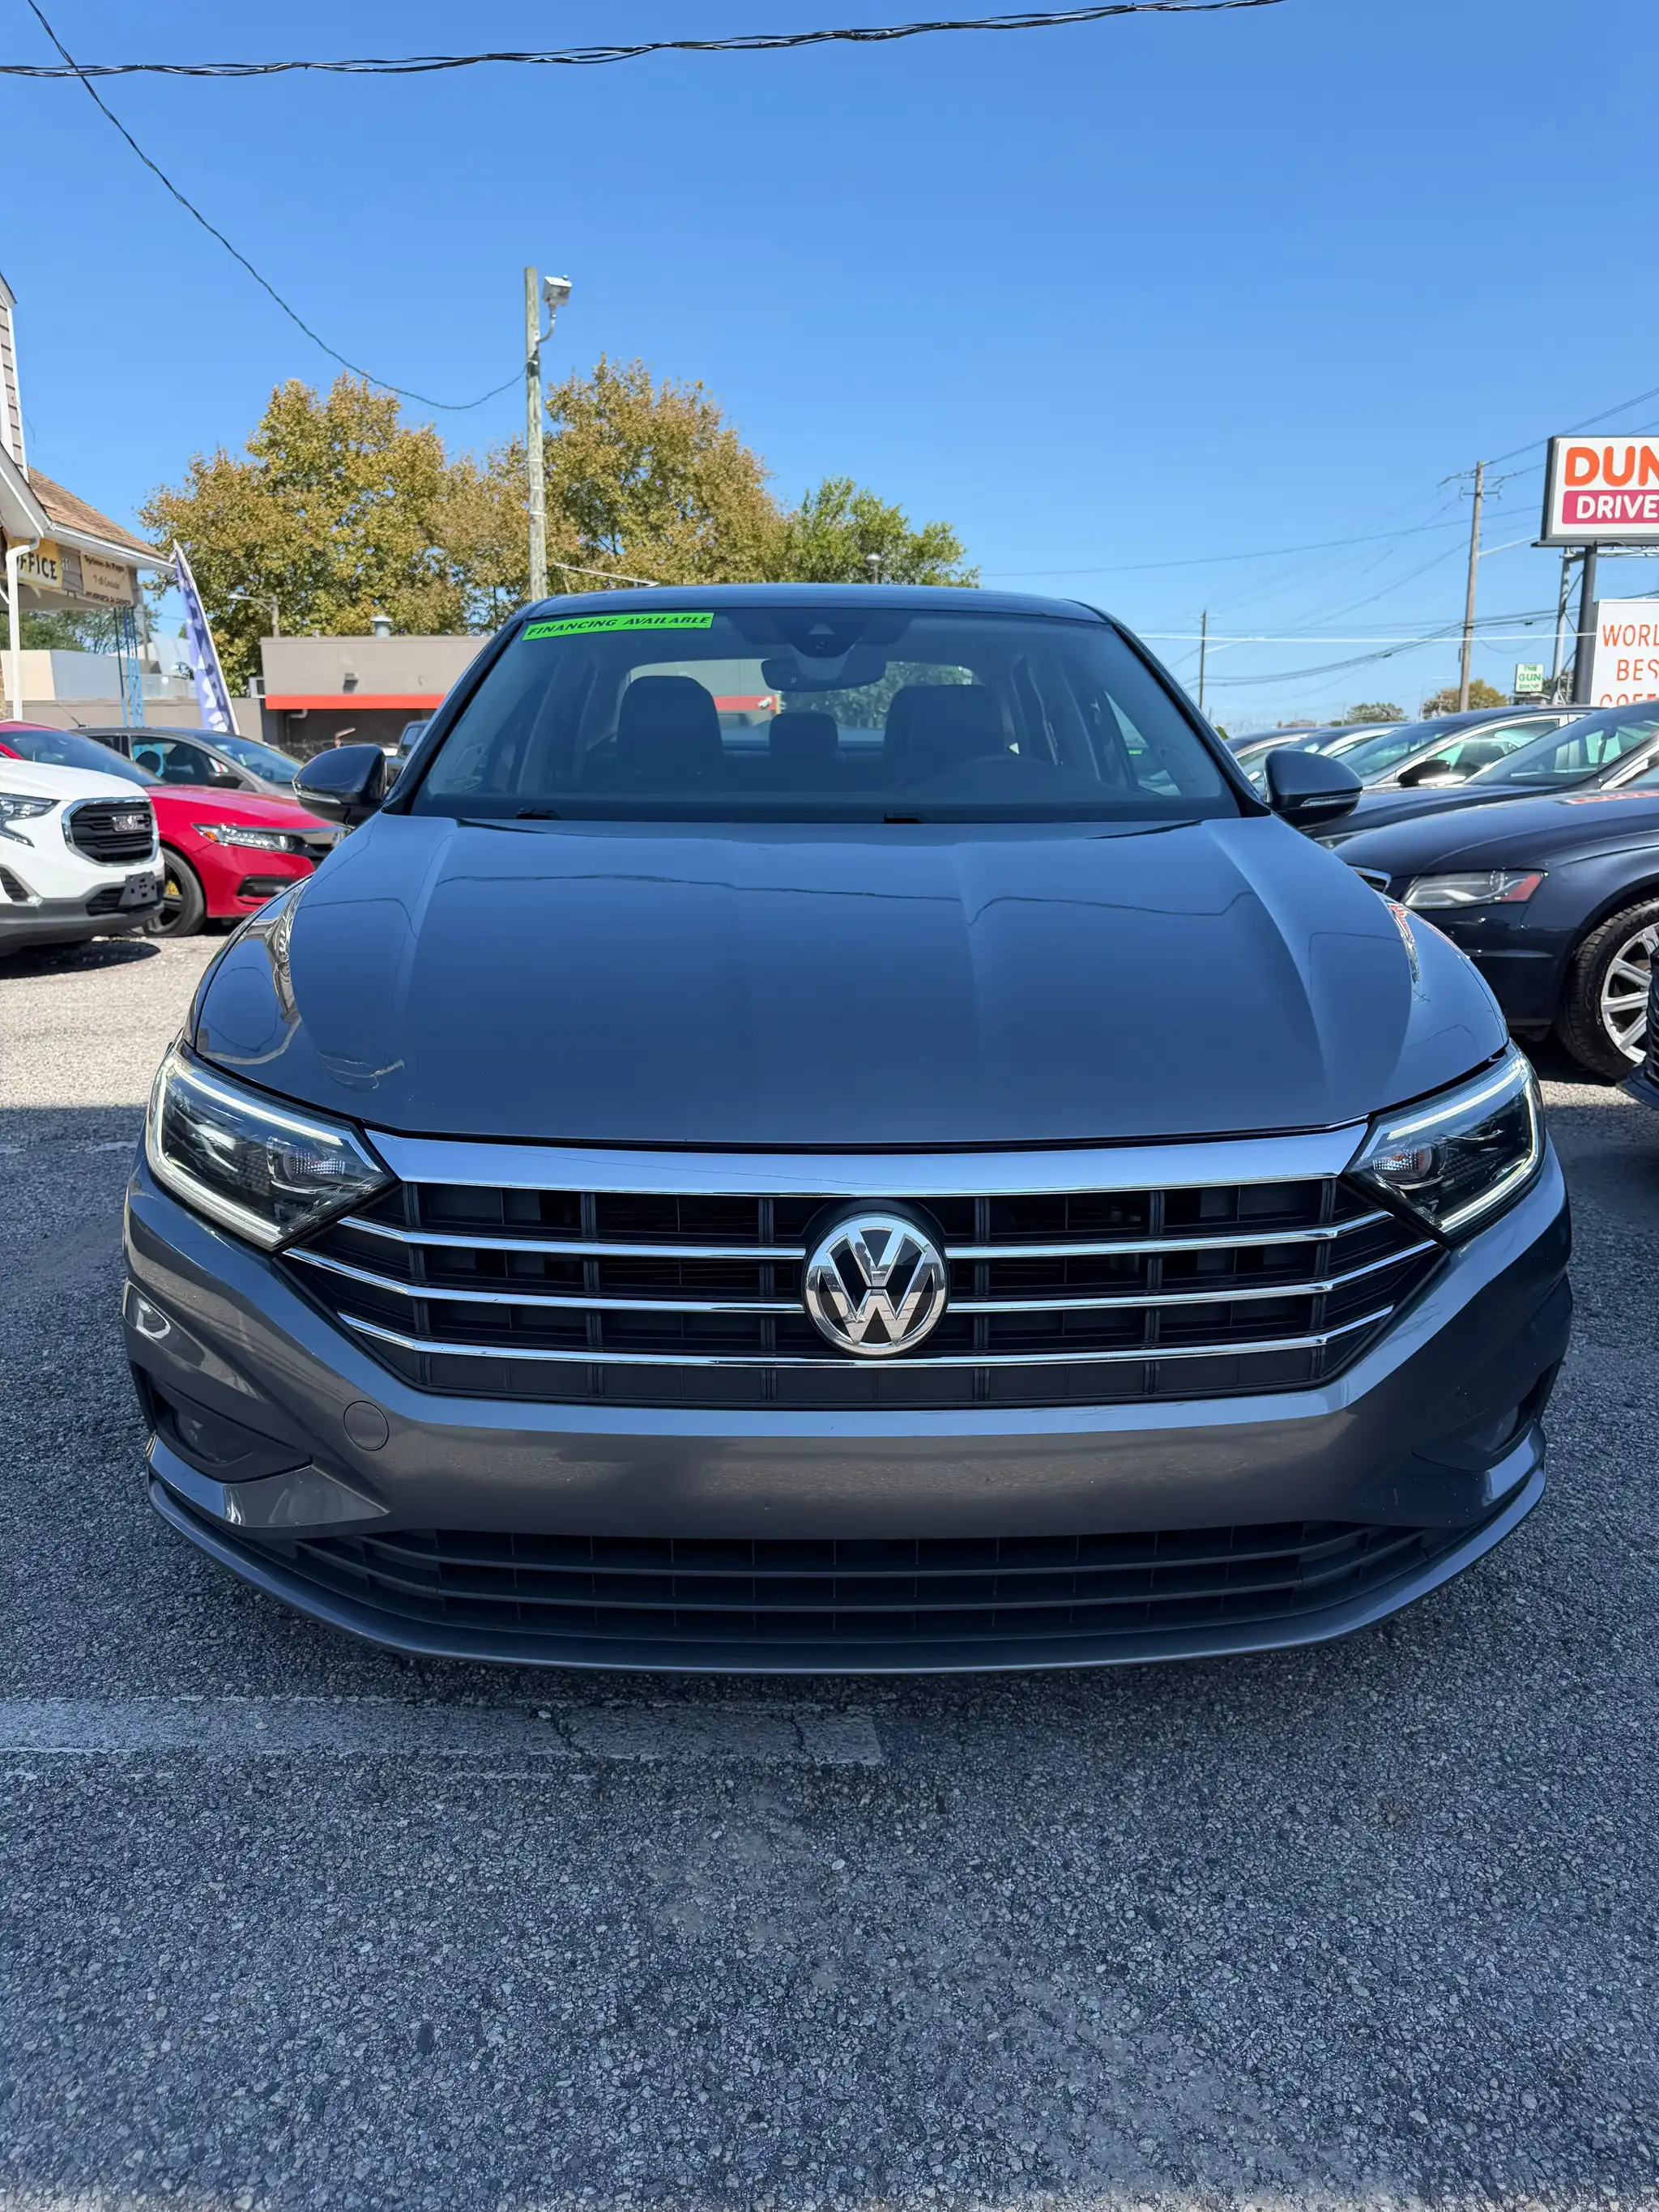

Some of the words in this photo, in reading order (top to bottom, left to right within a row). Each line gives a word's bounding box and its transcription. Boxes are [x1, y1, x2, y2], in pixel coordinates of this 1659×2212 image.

[1564, 445, 1659, 487] DUN
[1576, 495, 1659, 519] DRIVE
[17, 552, 58, 580] FFICE
[527, 619, 618, 636] FINANCING
[623, 616, 711, 626] AVAILABLE
[1518, 673, 1542, 681] GUN
